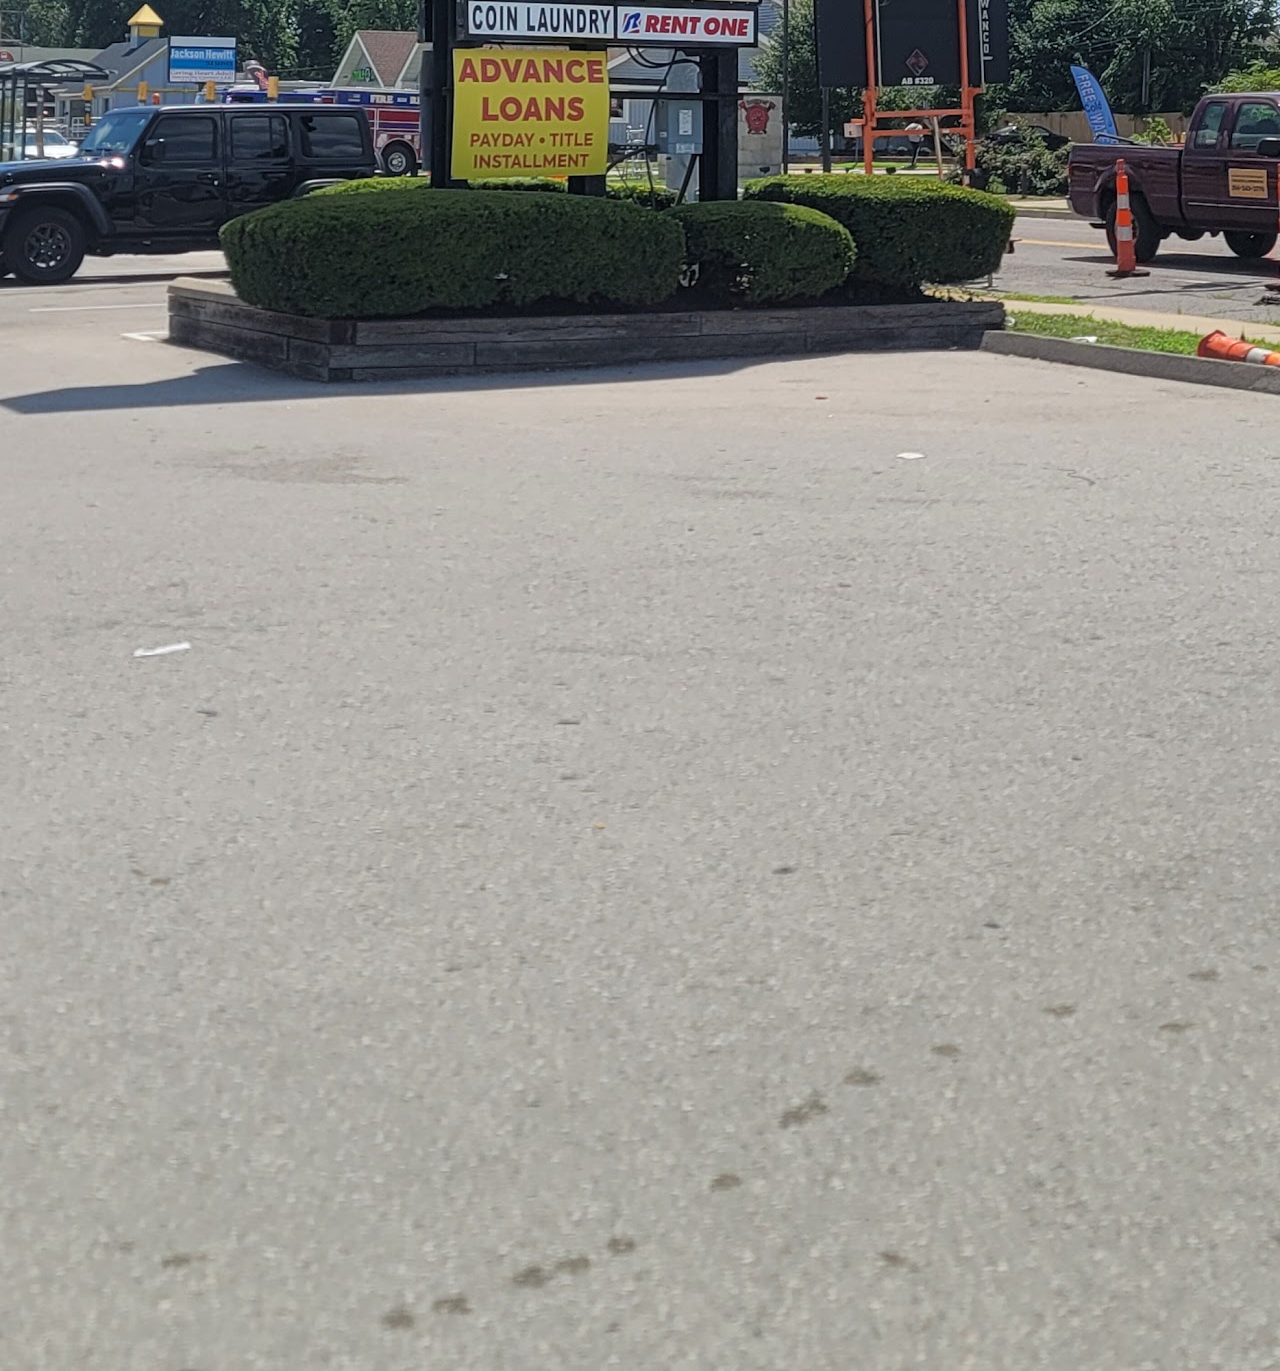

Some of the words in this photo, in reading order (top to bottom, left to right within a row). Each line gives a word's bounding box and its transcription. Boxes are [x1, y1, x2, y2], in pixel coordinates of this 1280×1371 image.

[472, 4, 518, 32] COIN
[526, 7, 611, 35] LAUNDRY
[645, 15, 701, 35] RENT
[703, 17, 749, 37] ONE
[170, 49, 205, 59] Jackson
[205, 49, 234, 60] Hewitt
[458, 57, 604, 84] ADVANCE
[901, 77, 913, 85] AB
[1076, 73, 1097, 103] FREE
[369, 94, 394, 104] FIRE
[481, 96, 585, 122] LOANS
[469, 133, 535, 148] PAYDAY
[549, 132, 594, 147] TITLE
[473, 153, 590, 170] INSTALLMENT
